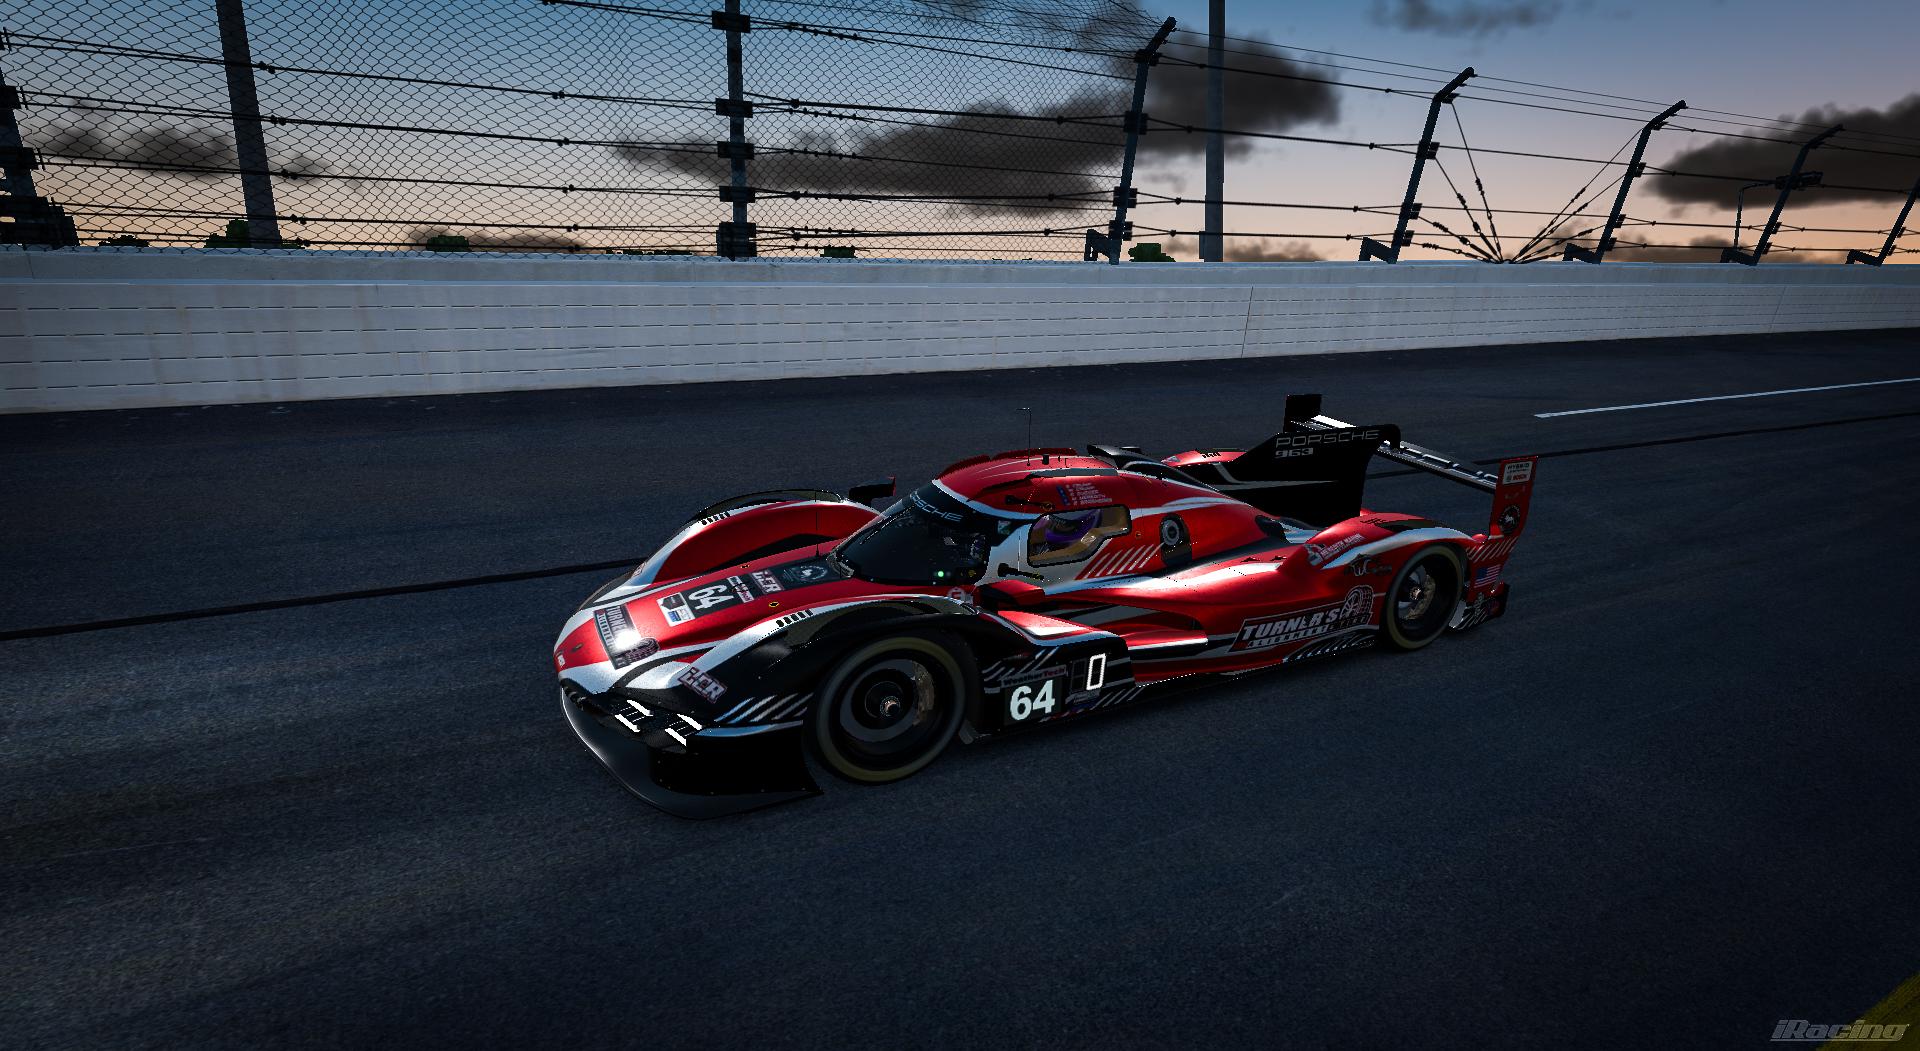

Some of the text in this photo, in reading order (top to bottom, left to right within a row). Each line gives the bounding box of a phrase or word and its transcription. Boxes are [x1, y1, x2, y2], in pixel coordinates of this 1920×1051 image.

[1275, 430, 1381, 448] PORSCHE
[1274, 447, 1314, 459] 963
[688, 584, 734, 610] 64
[1242, 608, 1341, 640] TURNER'S
[1010, 680, 1056, 721] 64
